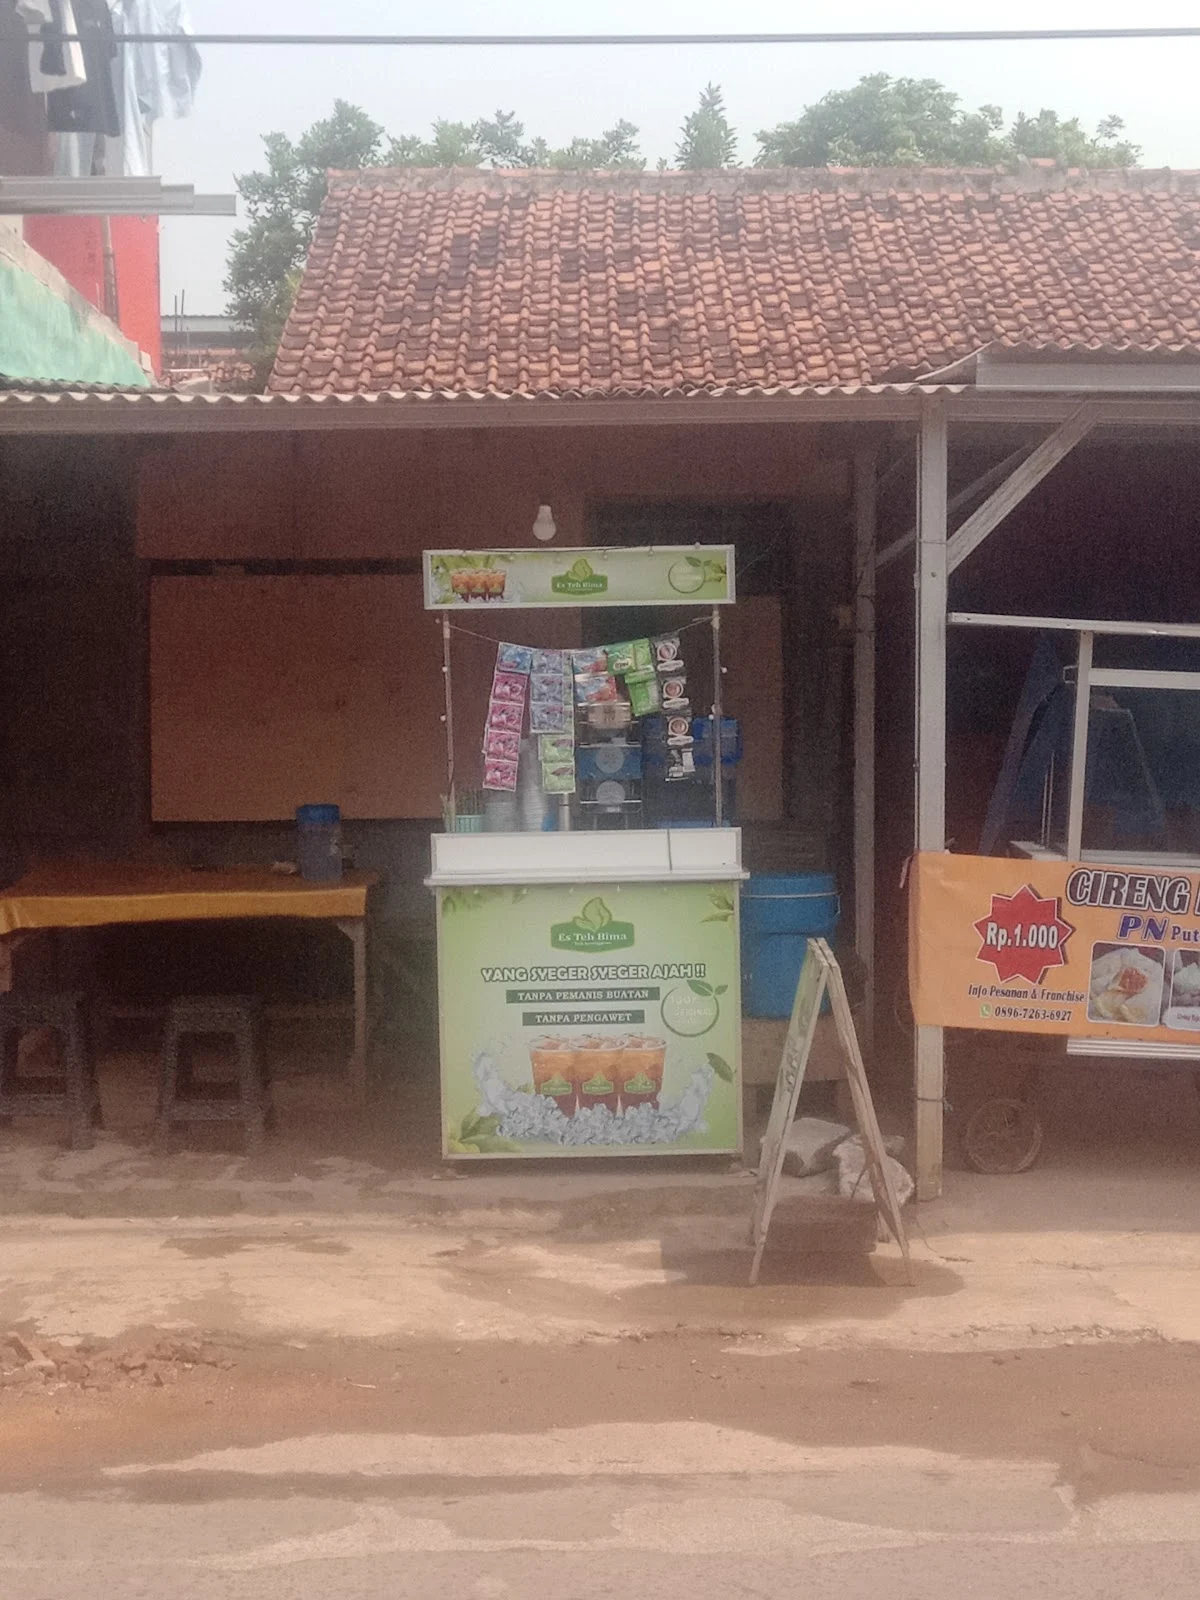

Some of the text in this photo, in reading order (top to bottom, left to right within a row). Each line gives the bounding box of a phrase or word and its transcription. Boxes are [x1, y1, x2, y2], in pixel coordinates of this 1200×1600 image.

[1066, 867, 1191, 914] CIRENG
[558, 932, 627, 941] Es Teh Bima
[986, 921, 1059, 951] Rp.1.000
[1117, 913, 1169, 942] PN
[481, 967, 528, 982] YANG
[530, 966, 591, 981] SYEGER
[591, 964, 648, 980] SYEGER
[650, 963, 693, 980] AJAH
[518, 989, 649, 1001] TANPA PEMANIS BUATAN
[968, 984, 1085, 1002] Info Pesanan & Franchise
[535, 1012, 633, 1023] TANPA PENGAWET
[994, 1006, 1072, 1021] 0896-7263-6927
